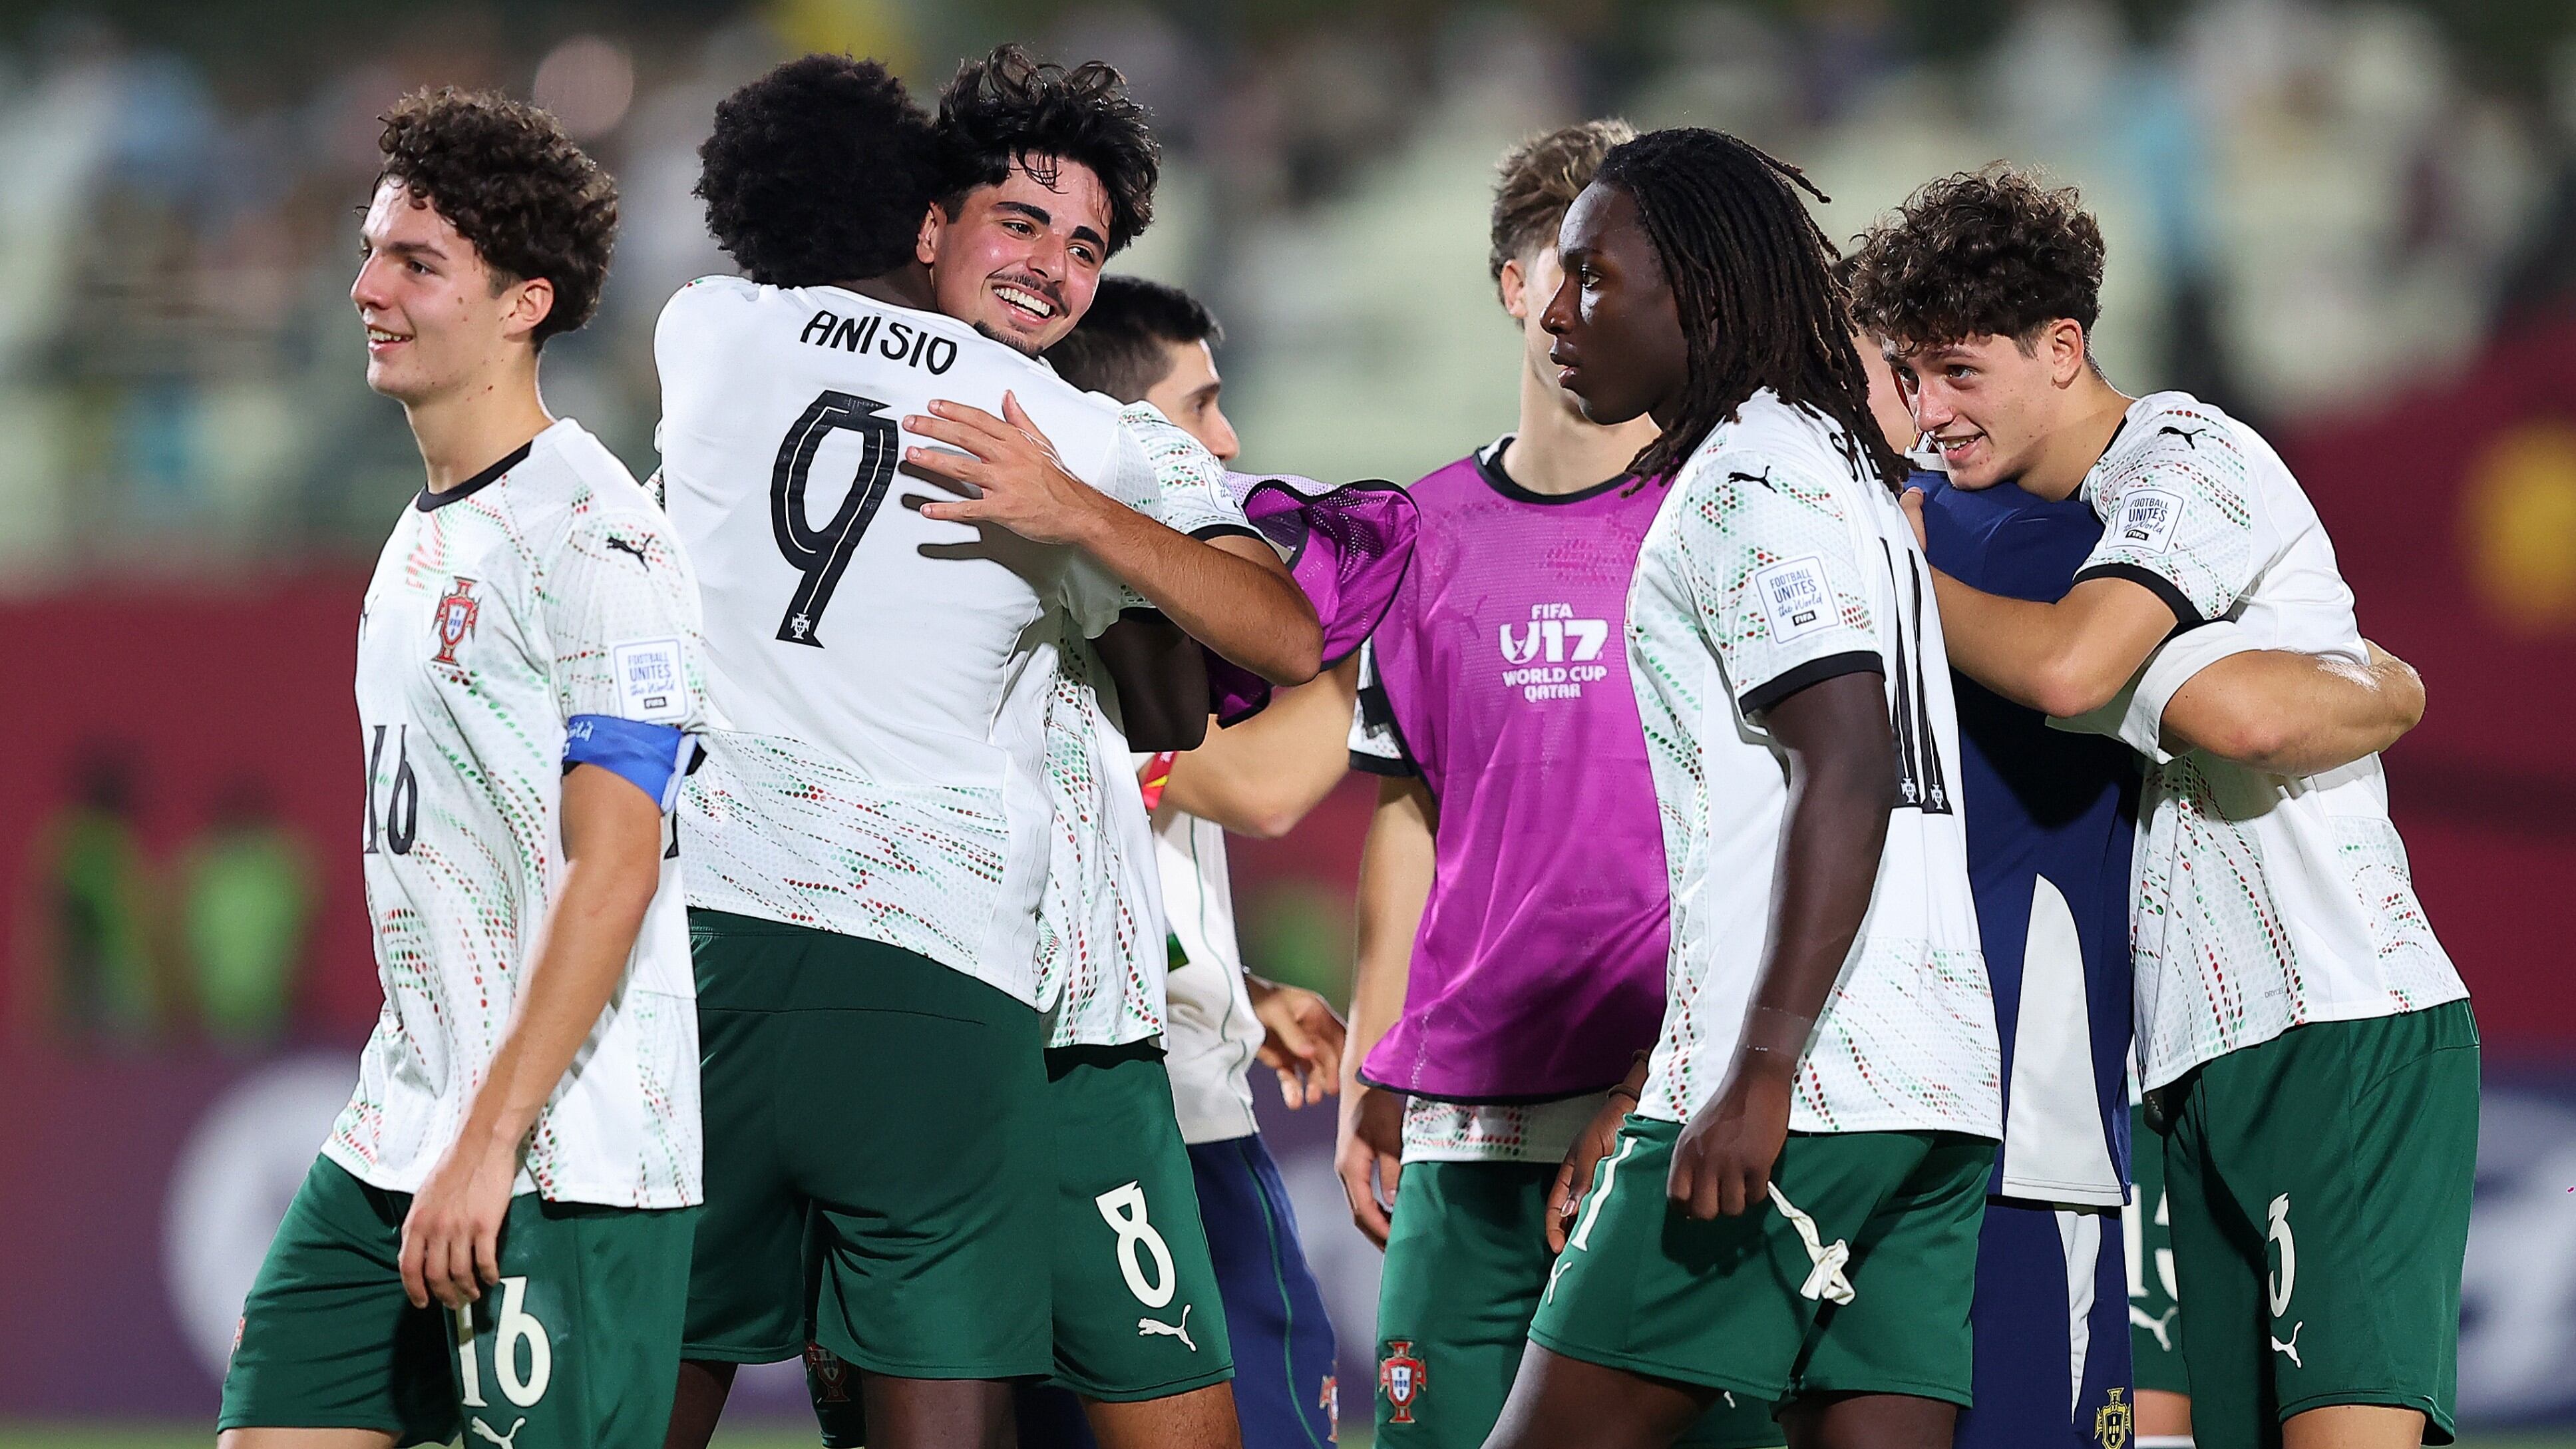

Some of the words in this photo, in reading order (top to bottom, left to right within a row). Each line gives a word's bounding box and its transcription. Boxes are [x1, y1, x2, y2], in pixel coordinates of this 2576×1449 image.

[800, 310, 957, 375] ANISIO
[2128, 508, 2167, 522] UNITES
[2129, 498, 2169, 510] FOOTBALL
[770, 389, 899, 649] 9
[2127, 530, 2146, 540] FIFA
[1769, 568, 1812, 590] FOOTBALL
[1773, 578, 1817, 604] UNITES
[1531, 602, 1574, 620] FIFA
[1777, 603, 1793, 618] the
[1792, 591, 1823, 611] World
[1793, 612, 1815, 624] FIFA
[1499, 619, 1609, 665] U17
[629, 664, 671, 682] UNITES
[1501, 667, 1567, 688] WORLD
[1569, 665, 1608, 682] CUP
[1523, 683, 1582, 704] QATAR
[364, 724, 418, 855] 16
[1095, 1179, 1177, 1309] 8
[2268, 1191, 2296, 1319] 3
[455, 1275, 552, 1408] 16
